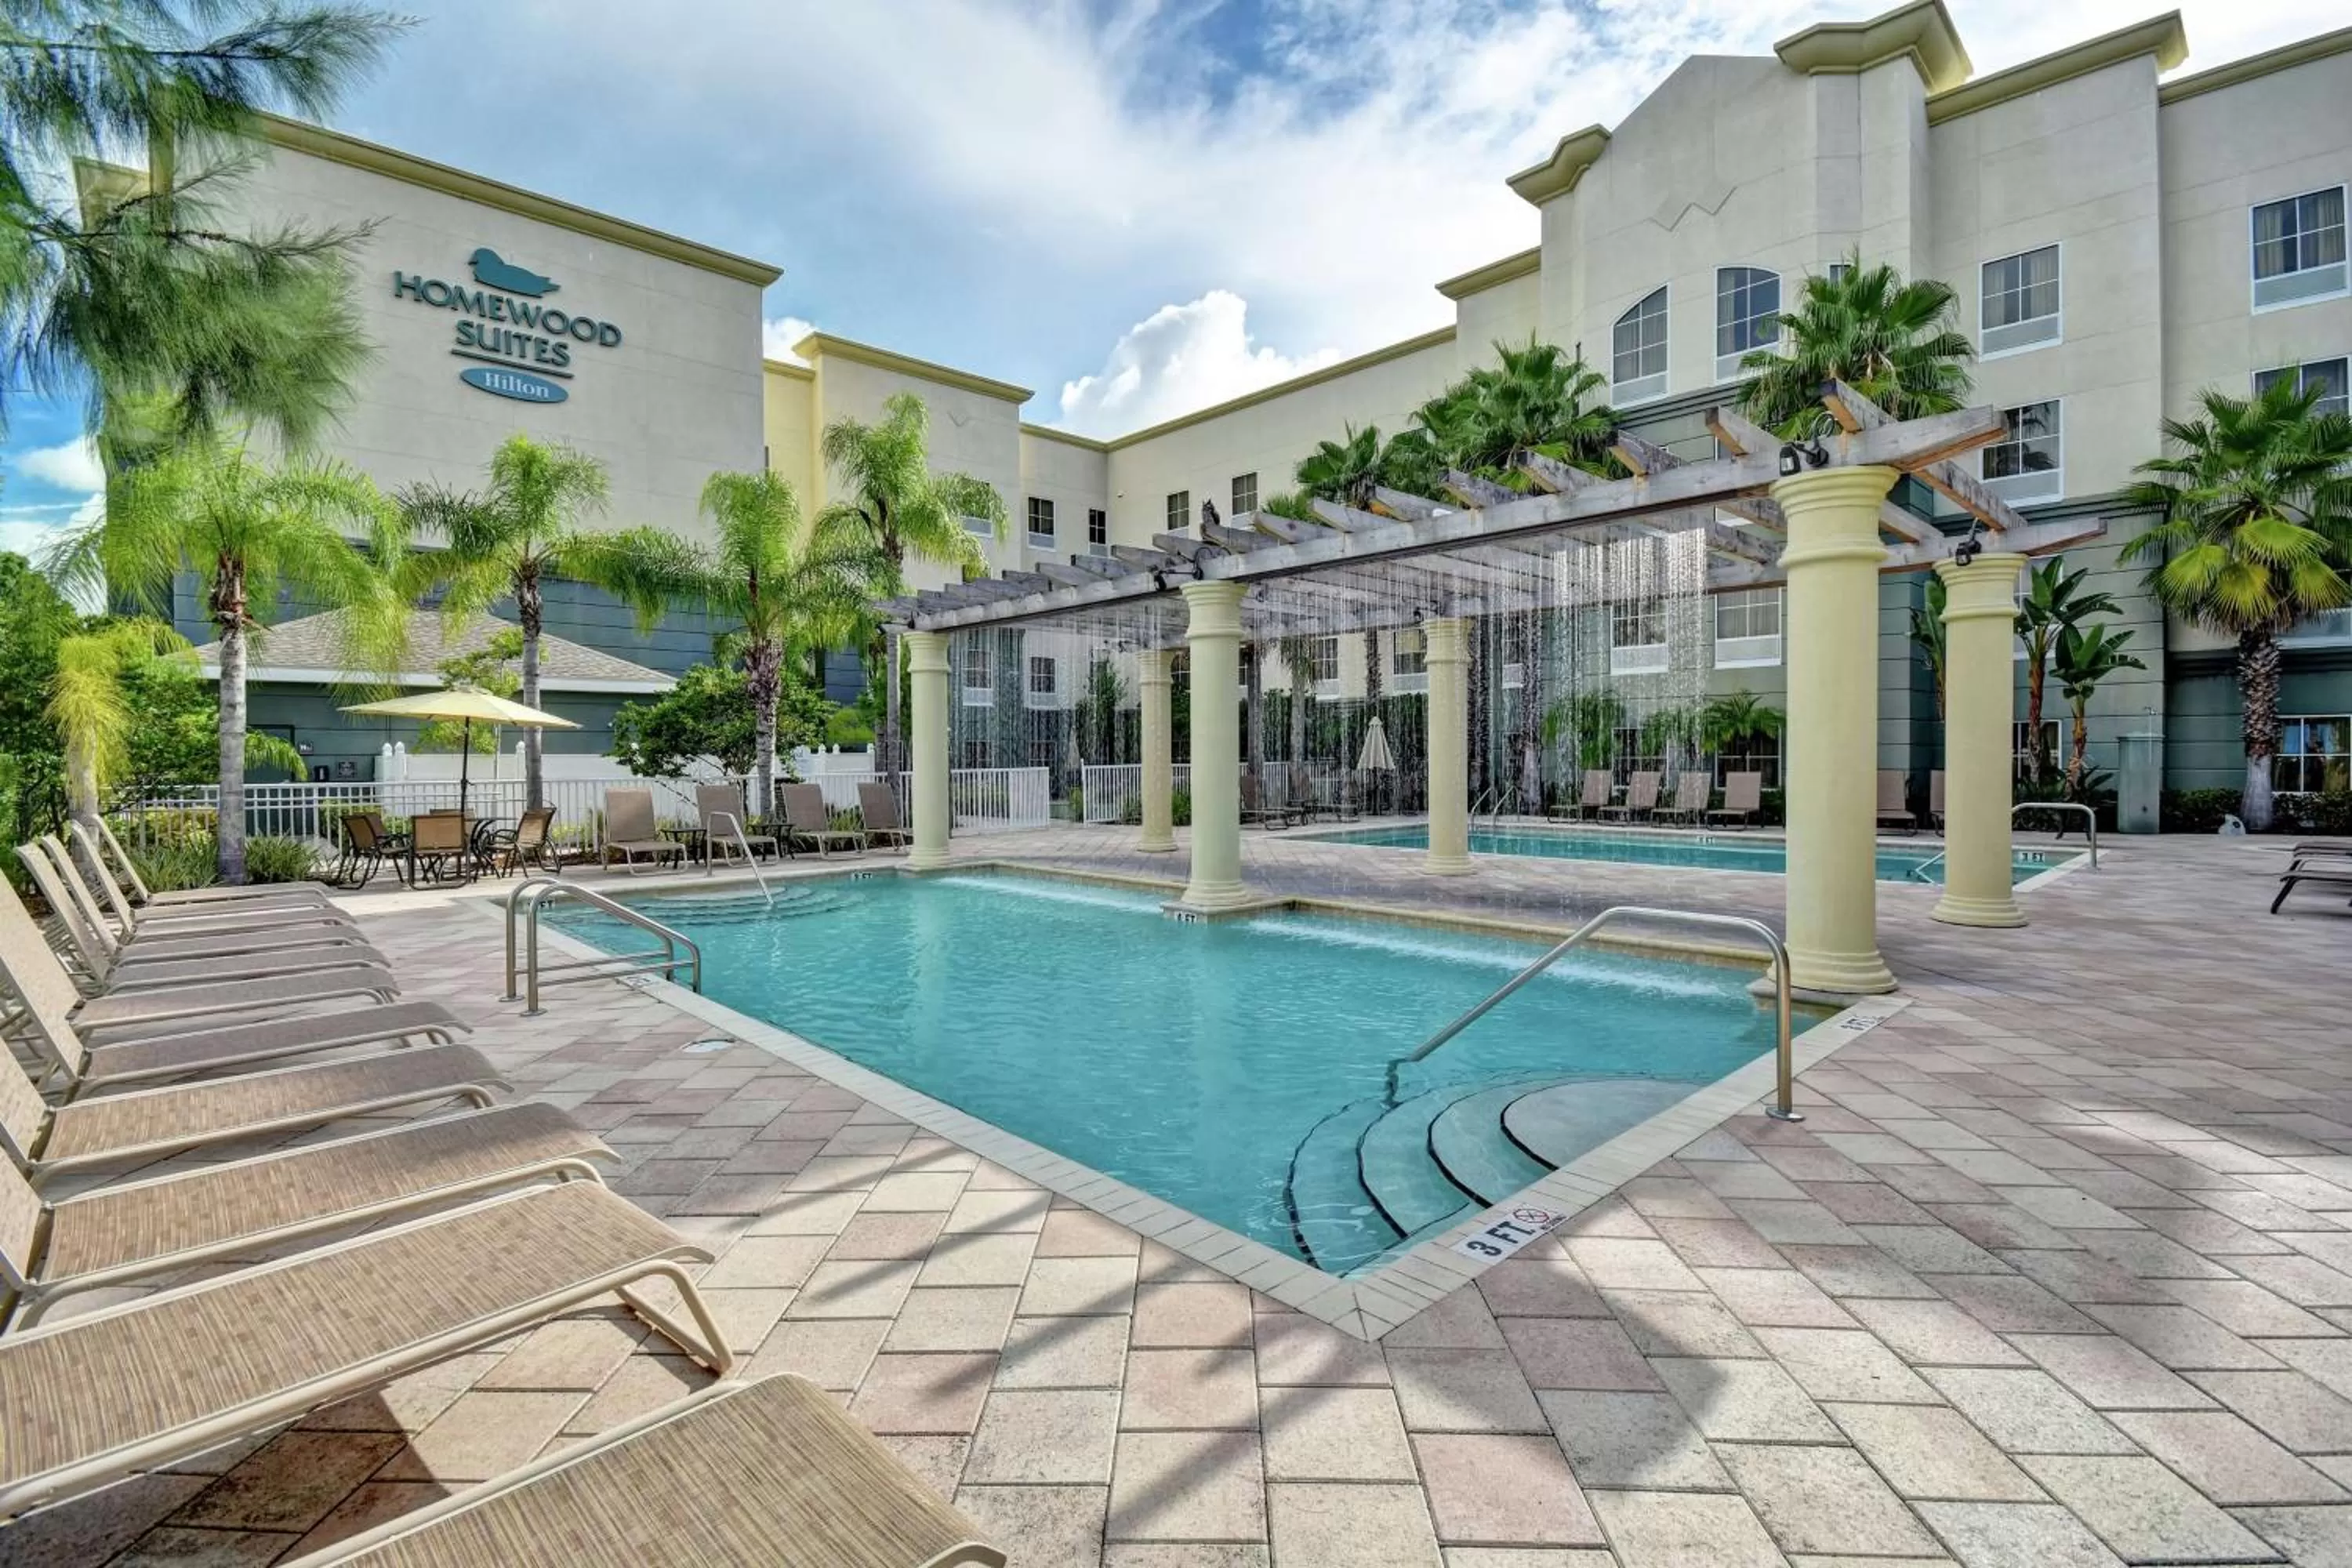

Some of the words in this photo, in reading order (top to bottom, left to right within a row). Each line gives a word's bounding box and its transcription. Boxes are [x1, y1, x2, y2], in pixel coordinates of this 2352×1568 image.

[392, 270, 622, 347] HOMEWOOD
[456, 319, 572, 367] SUITES
[484, 371, 549, 399] Hilton
[1467, 1240, 1502, 1257] 3
